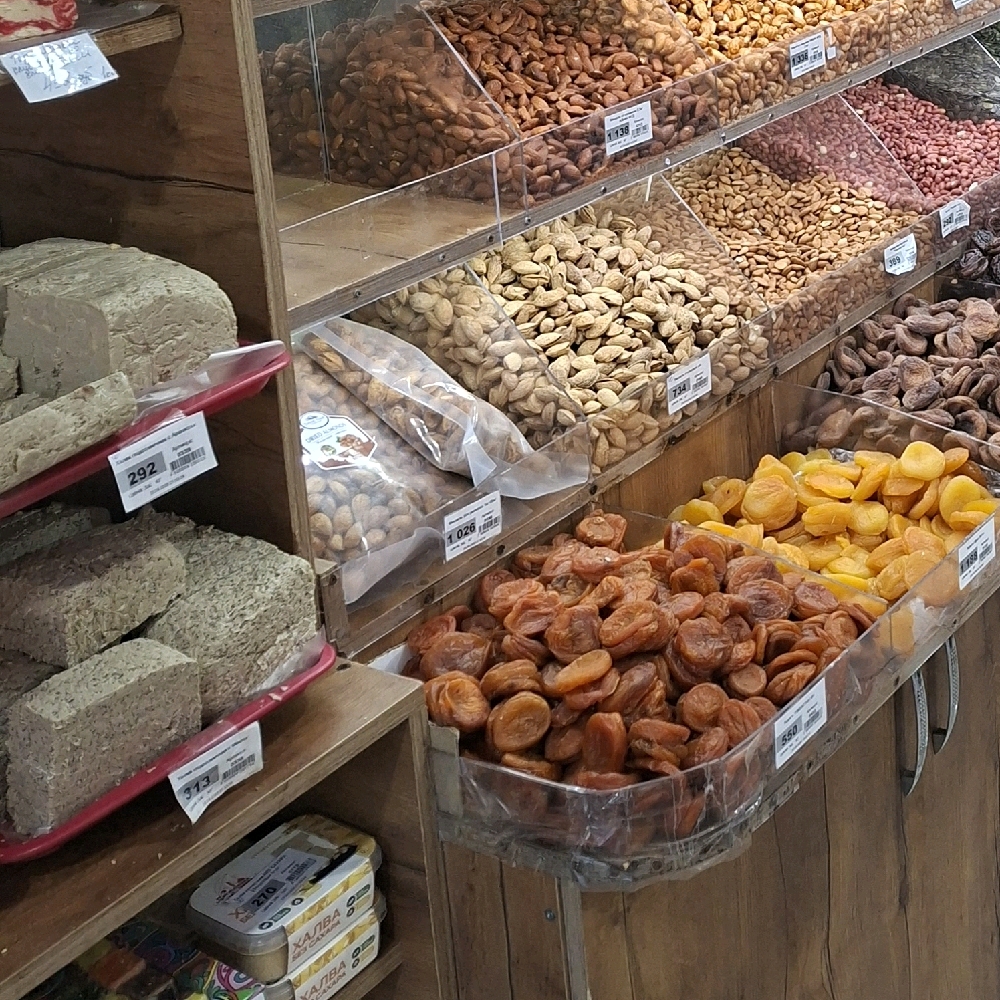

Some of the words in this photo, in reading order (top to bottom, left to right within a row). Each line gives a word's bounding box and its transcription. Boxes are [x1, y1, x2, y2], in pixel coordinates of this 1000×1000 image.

[671, 383, 687, 396] 734
[127, 461, 158, 486] 292
[456, 522, 476, 540] 026
[781, 726, 798, 746] 550
[183, 775, 210, 800] 313
[250, 887, 277, 907] 270
[293, 908, 341, 950] ХАЛВА
[308, 919, 341, 949] САХАРА
[300, 960, 347, 1000] ХАЛВА
